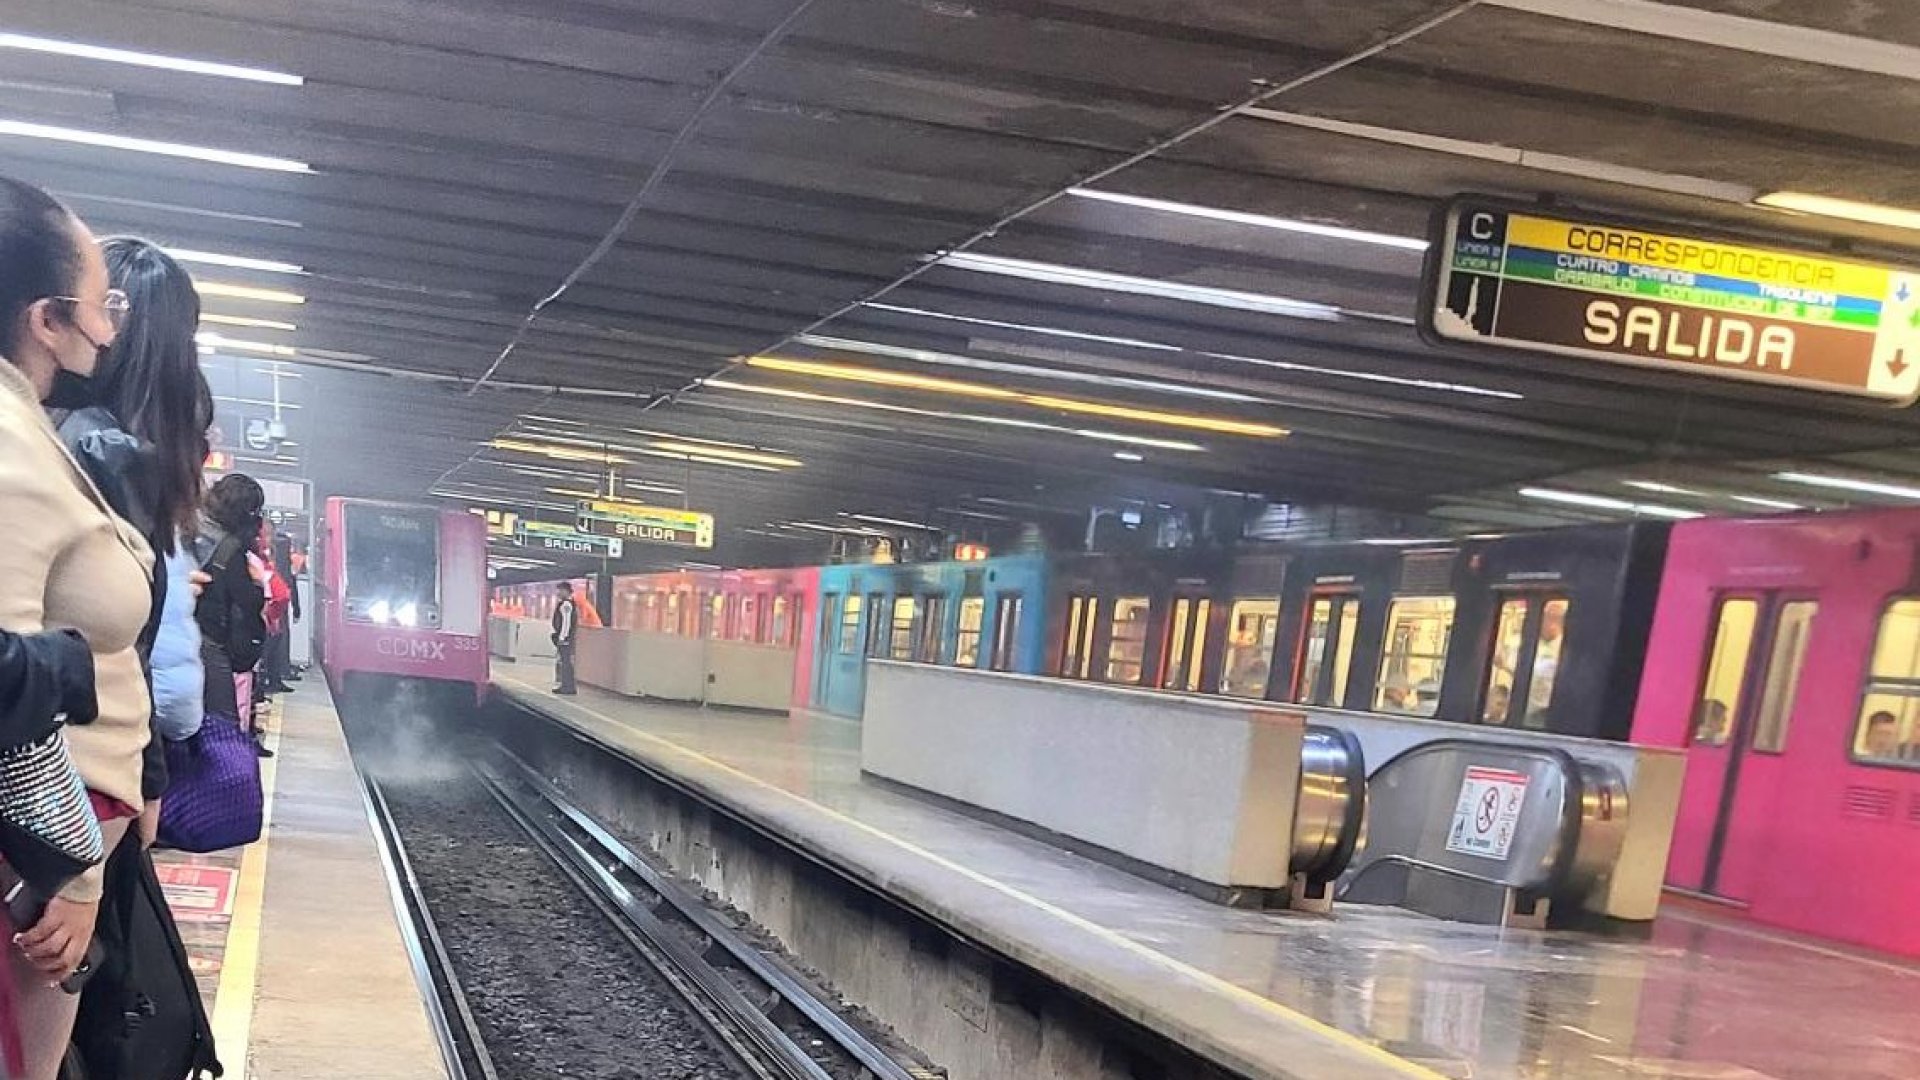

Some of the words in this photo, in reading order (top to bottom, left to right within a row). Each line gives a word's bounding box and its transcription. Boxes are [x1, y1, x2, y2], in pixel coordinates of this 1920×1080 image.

[1471, 213, 1494, 240] C
[1556, 253, 1619, 275] CUATRO
[1567, 228, 1835, 285] CORRESPONDENCIA
[1554, 268, 1637, 292] GARIBALDI
[1584, 300, 1796, 371] SALIDA
[615, 523, 675, 541] SALIDA
[544, 537, 592, 553] SALIDA
[377, 638, 445, 660] CDMX
